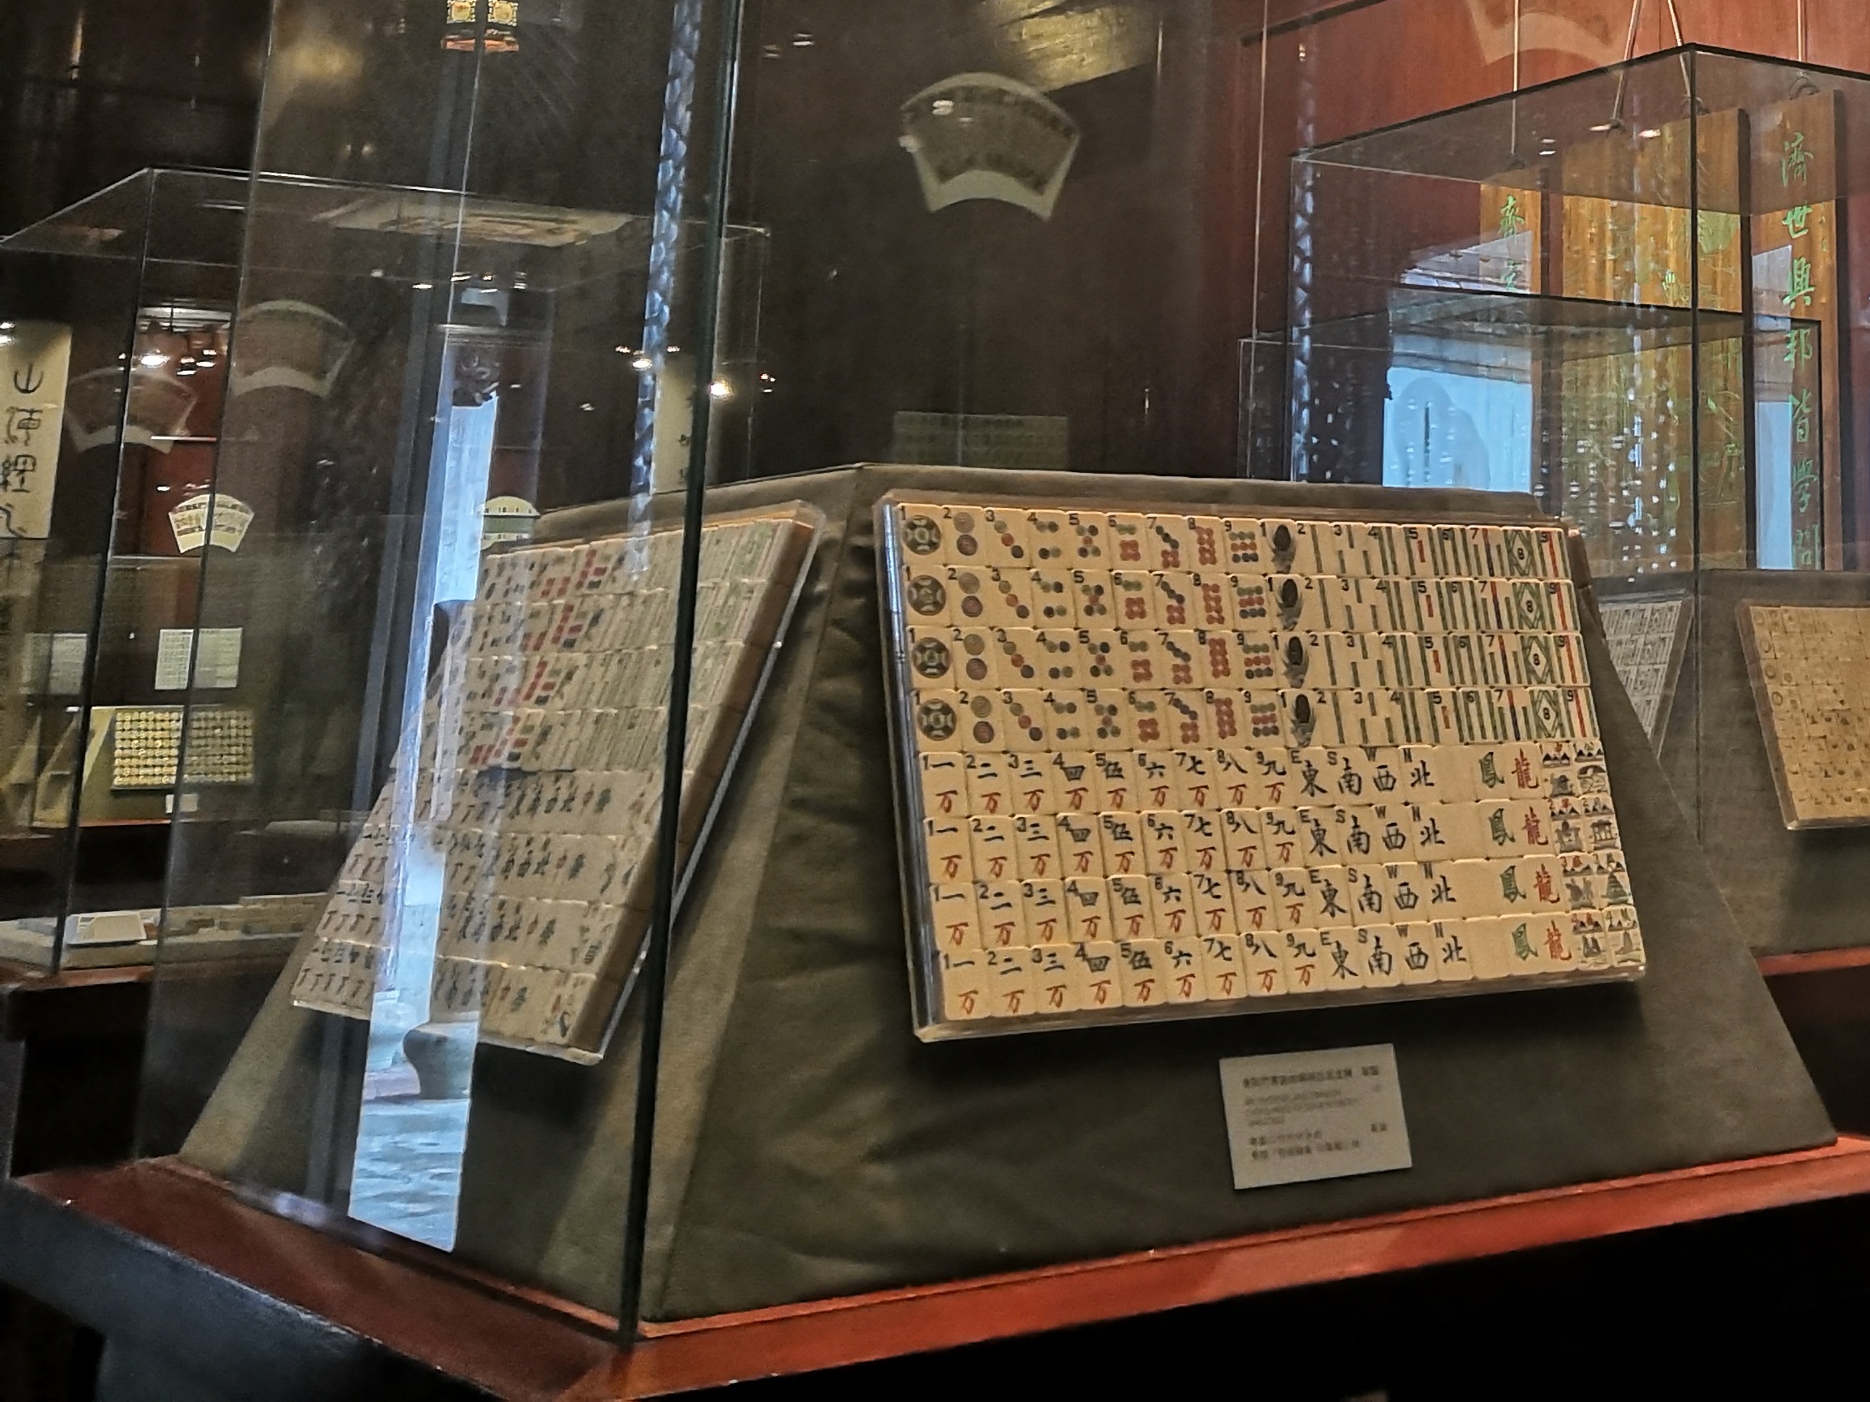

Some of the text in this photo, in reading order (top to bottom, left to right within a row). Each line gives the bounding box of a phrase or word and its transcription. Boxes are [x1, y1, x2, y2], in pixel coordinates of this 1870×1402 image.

[1301, 760, 1327, 797] 東
[1337, 757, 1362, 795] 南
[1373, 765, 1397, 791] 西
[1411, 760, 1435, 787] 北
[1511, 748, 1540, 789] 龍
[1309, 819, 1336, 857] 東
[1346, 815, 1370, 854] 南
[1382, 823, 1406, 850] 西
[1420, 818, 1444, 845] 北
[1521, 804, 1549, 845] 龍
[1320, 880, 1347, 917] 東
[1358, 875, 1382, 913] 南
[1394, 882, 1418, 909] 西
[1432, 875, 1456, 903] 北
[1532, 862, 1561, 903] 龍
[1368, 935, 1392, 974] 南
[1405, 943, 1429, 969] 西
[1442, 935, 1466, 962] 北
[1543, 919, 1572, 960] 龍
[1331, 942, 1358, 980] 東
